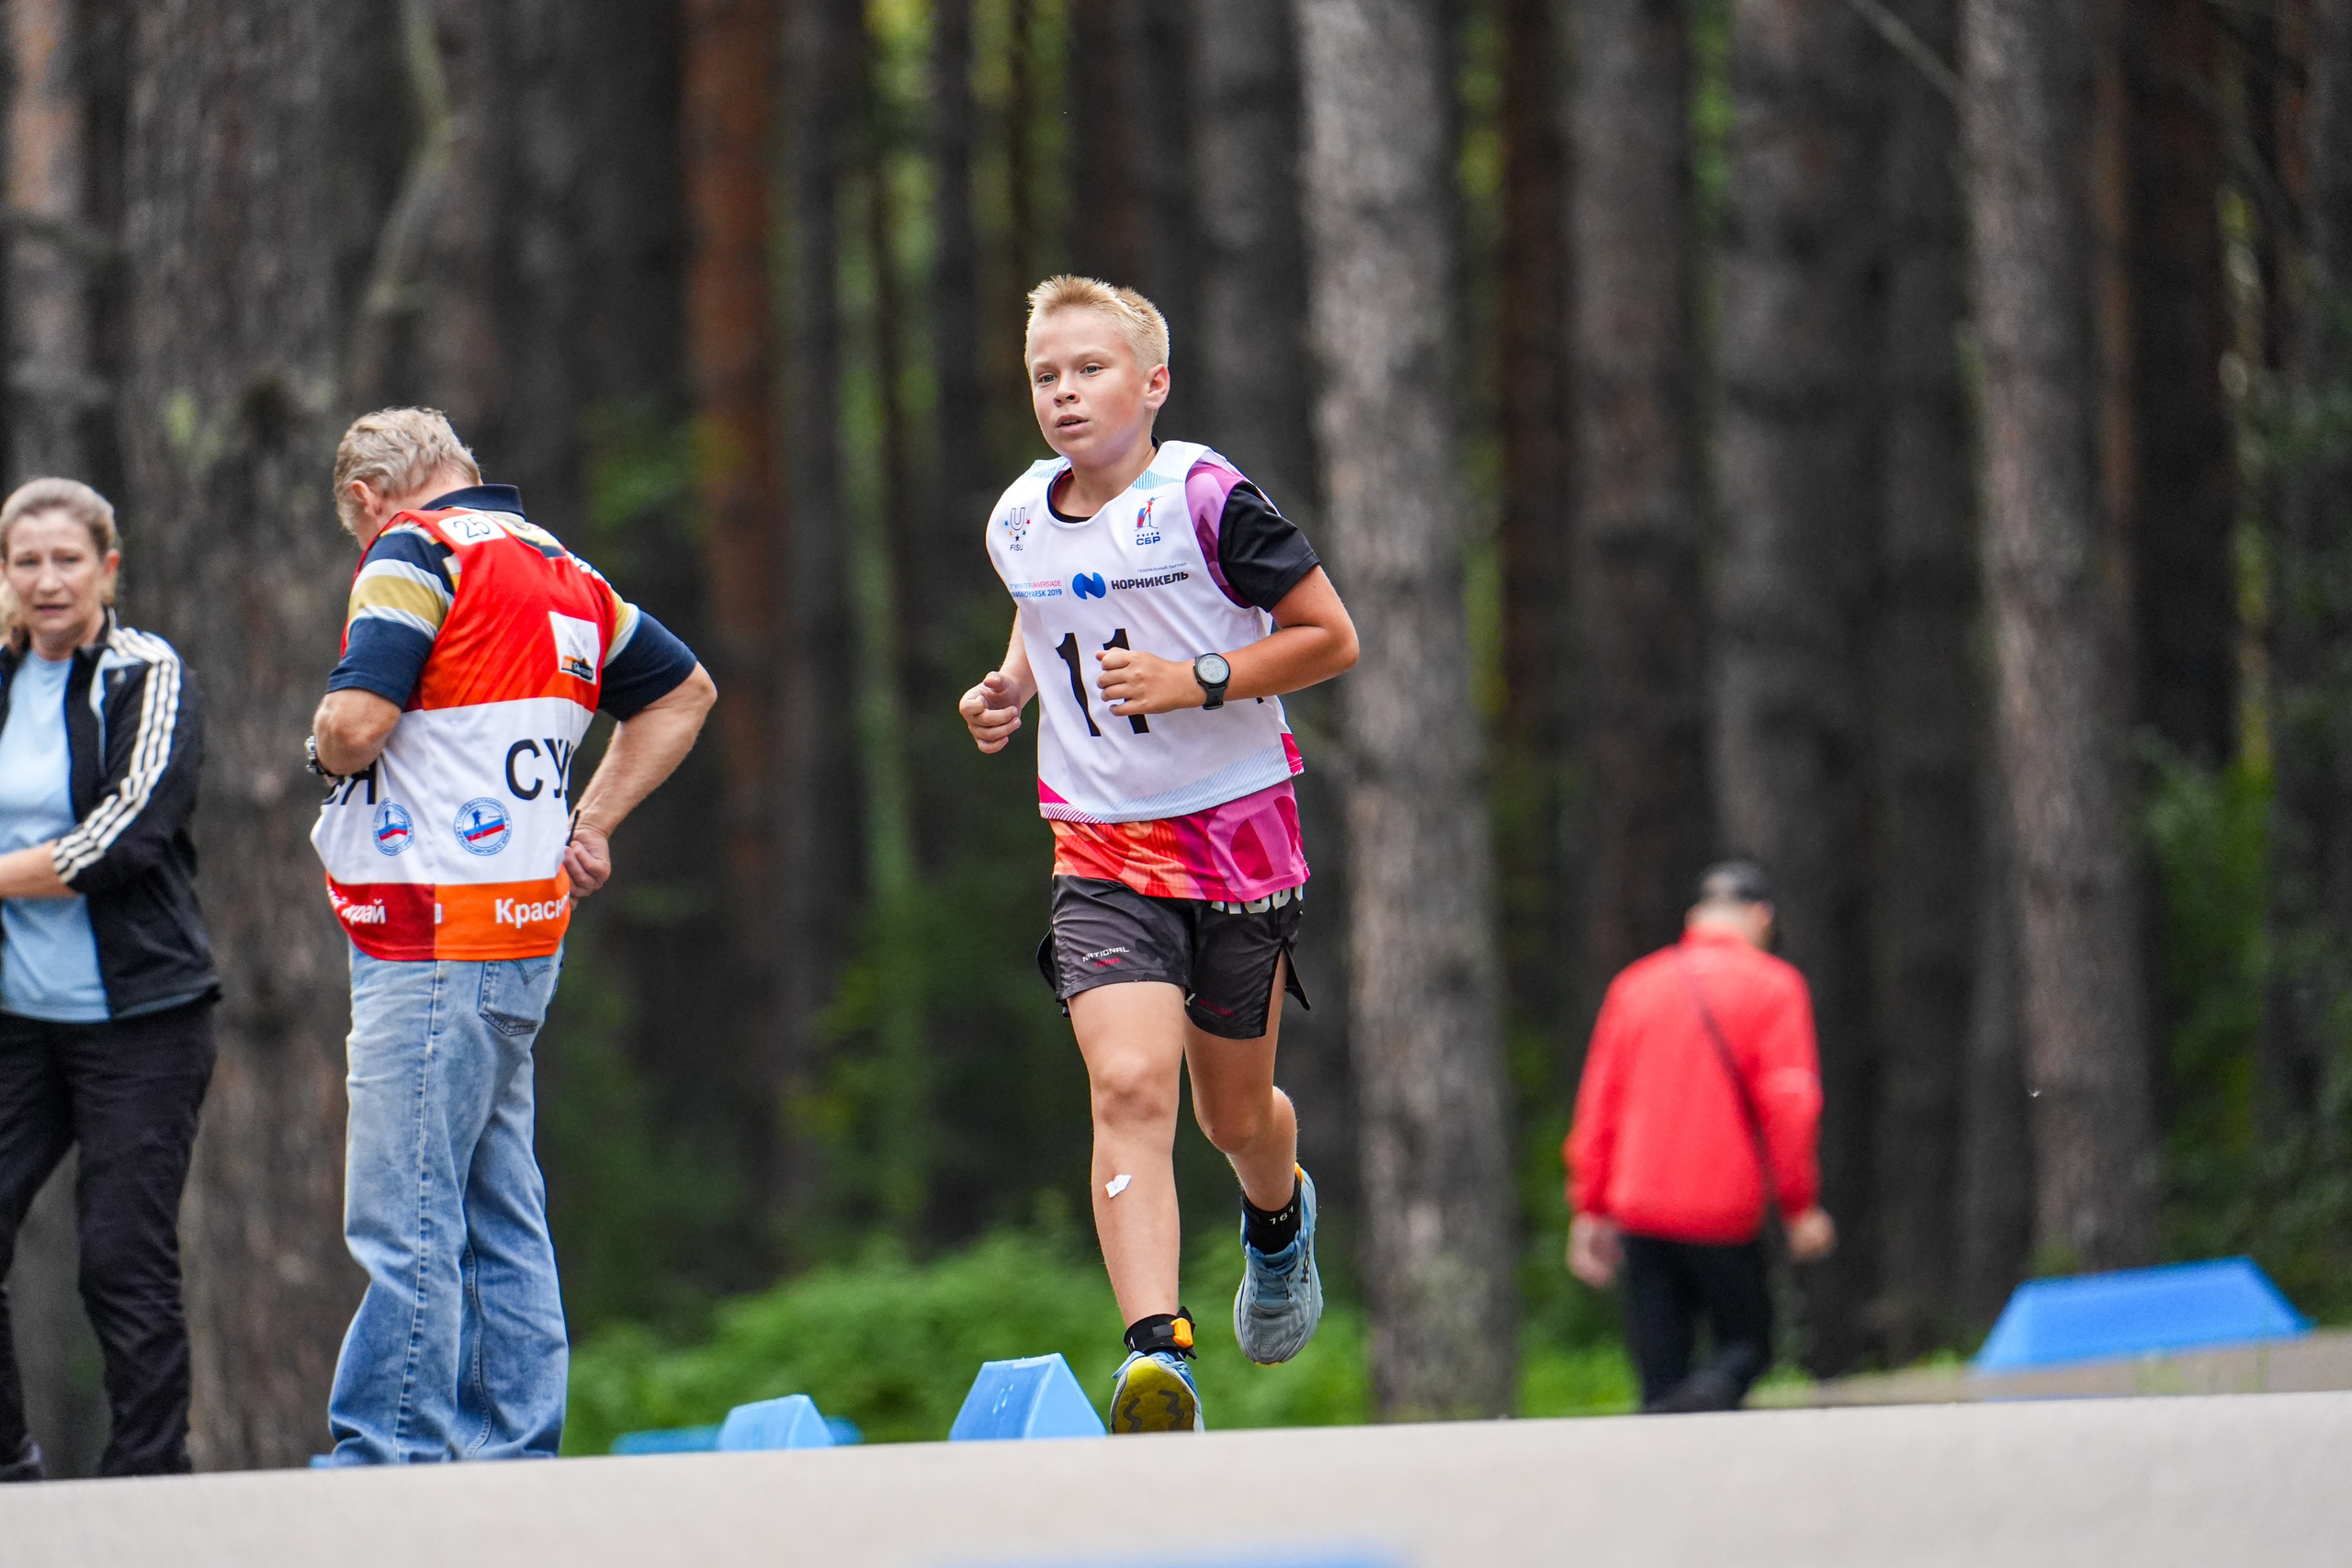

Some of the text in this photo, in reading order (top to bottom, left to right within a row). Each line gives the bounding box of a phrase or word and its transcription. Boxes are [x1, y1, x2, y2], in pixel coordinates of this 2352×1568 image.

[453, 516, 492, 539] 25
[1136, 536, 1161, 546] СБР
[1111, 571, 1189, 590] НОРНИКЕЛЬ
[1047, 588, 1063, 597] 2019
[1082, 946, 1130, 963] NATIONAL
